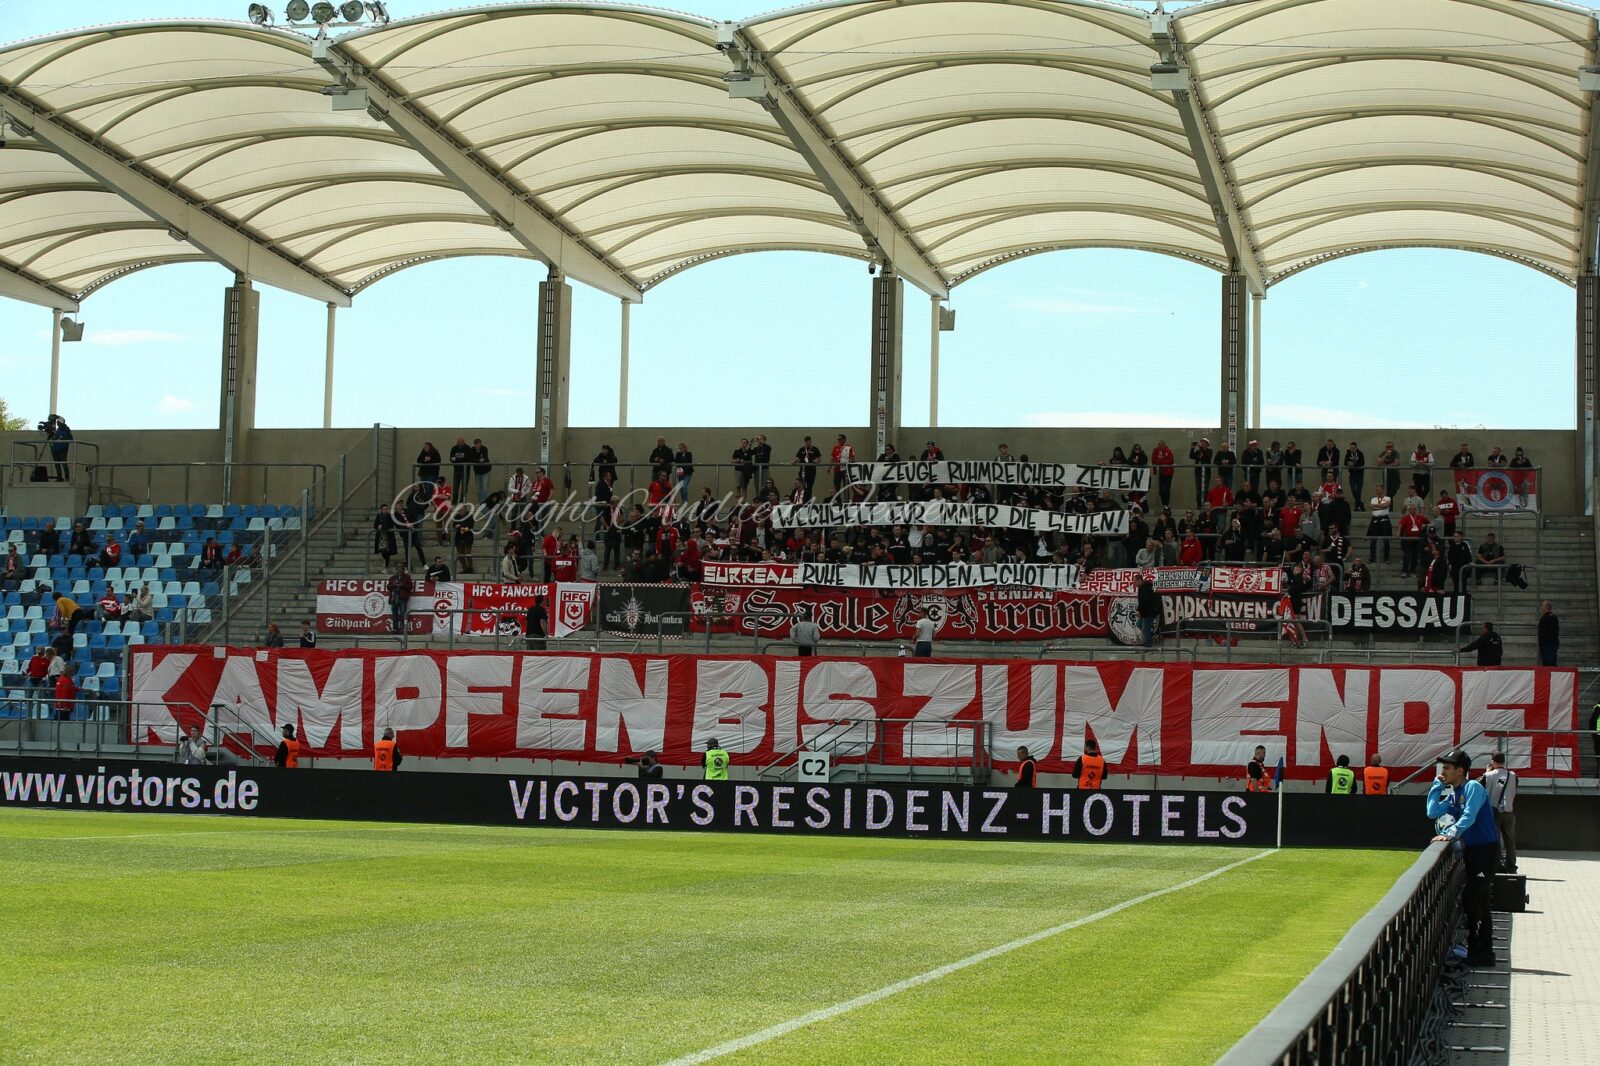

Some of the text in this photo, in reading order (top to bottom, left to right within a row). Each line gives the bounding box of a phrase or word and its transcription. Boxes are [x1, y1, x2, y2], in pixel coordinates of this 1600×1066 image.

[846, 462, 1145, 490] EIN ZEUGE RUHMREICHER ZEITEN
[779, 503, 877, 527] WECHSELT
[939, 503, 997, 527] IMMER
[1010, 507, 1038, 529] DIE
[1048, 508, 1125, 533] SEITEN!
[326, 579, 358, 592] HFC
[802, 563, 846, 586] RUHE
[859, 564, 877, 586] IN
[887, 564, 977, 587] FRIEDEN,
[472, 584, 493, 597] HFC
[501, 584, 549, 597] FANCLUB
[562, 592, 589, 601] HFC
[1161, 593, 1324, 626] BADKURVEN-CEW
[1331, 595, 1466, 629] DESSAU
[133, 647, 1574, 771] KÄMPFEN BIS ZUM ENDE!
[801, 758, 828, 778] C2
[0, 766, 260, 811] ww.victors.de
[508, 779, 1248, 840] VICTOR'S RESIDENZ-HOTELS
